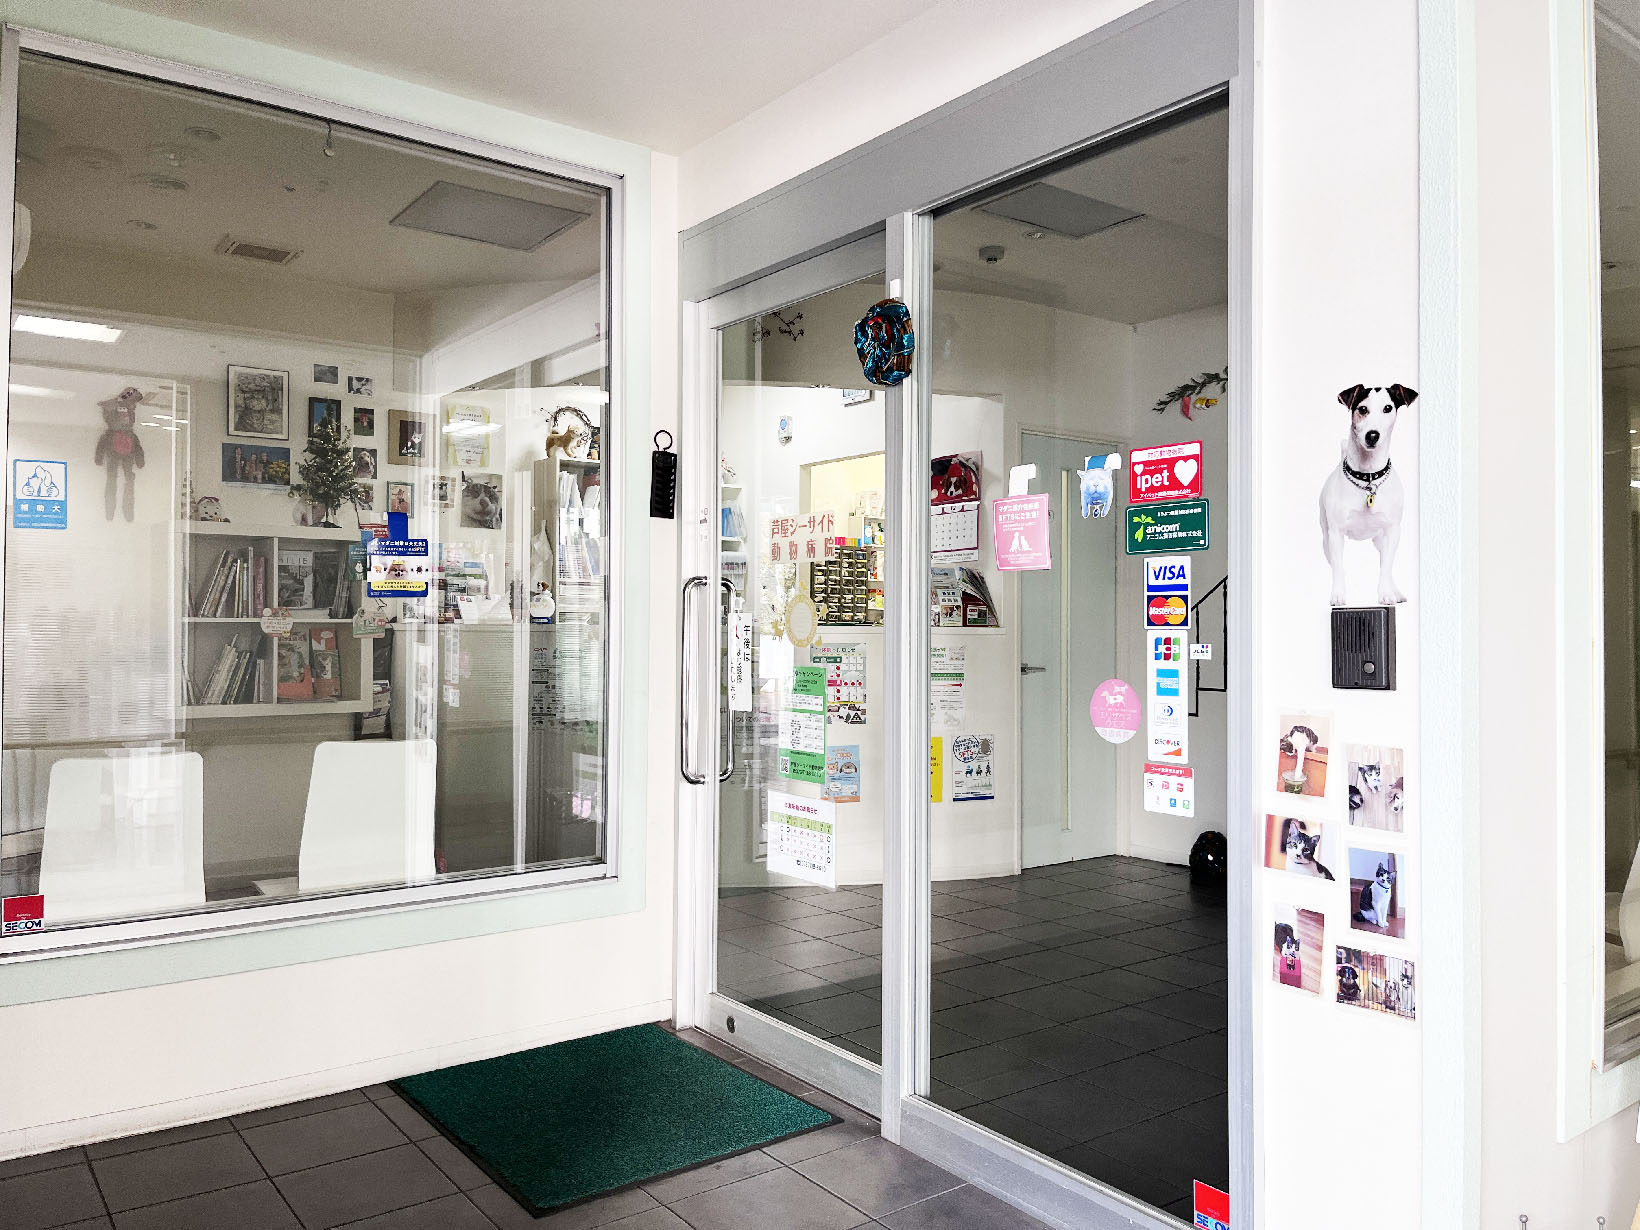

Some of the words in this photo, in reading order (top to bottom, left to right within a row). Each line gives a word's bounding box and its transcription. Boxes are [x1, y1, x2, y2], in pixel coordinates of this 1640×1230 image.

[1137, 470, 1169, 492] ipet
[771, 513, 834, 539] 芦屋シーサイド
[1146, 523, 1180, 534] anicom
[771, 536, 835, 561] 動物病院
[1151, 565, 1187, 580] VISA
[1149, 606, 1187, 615] MasterCard
[1155, 642, 1180, 656] JCB
[4, 919, 42, 931] SECOM
[1196, 1212, 1230, 1230] SECO
